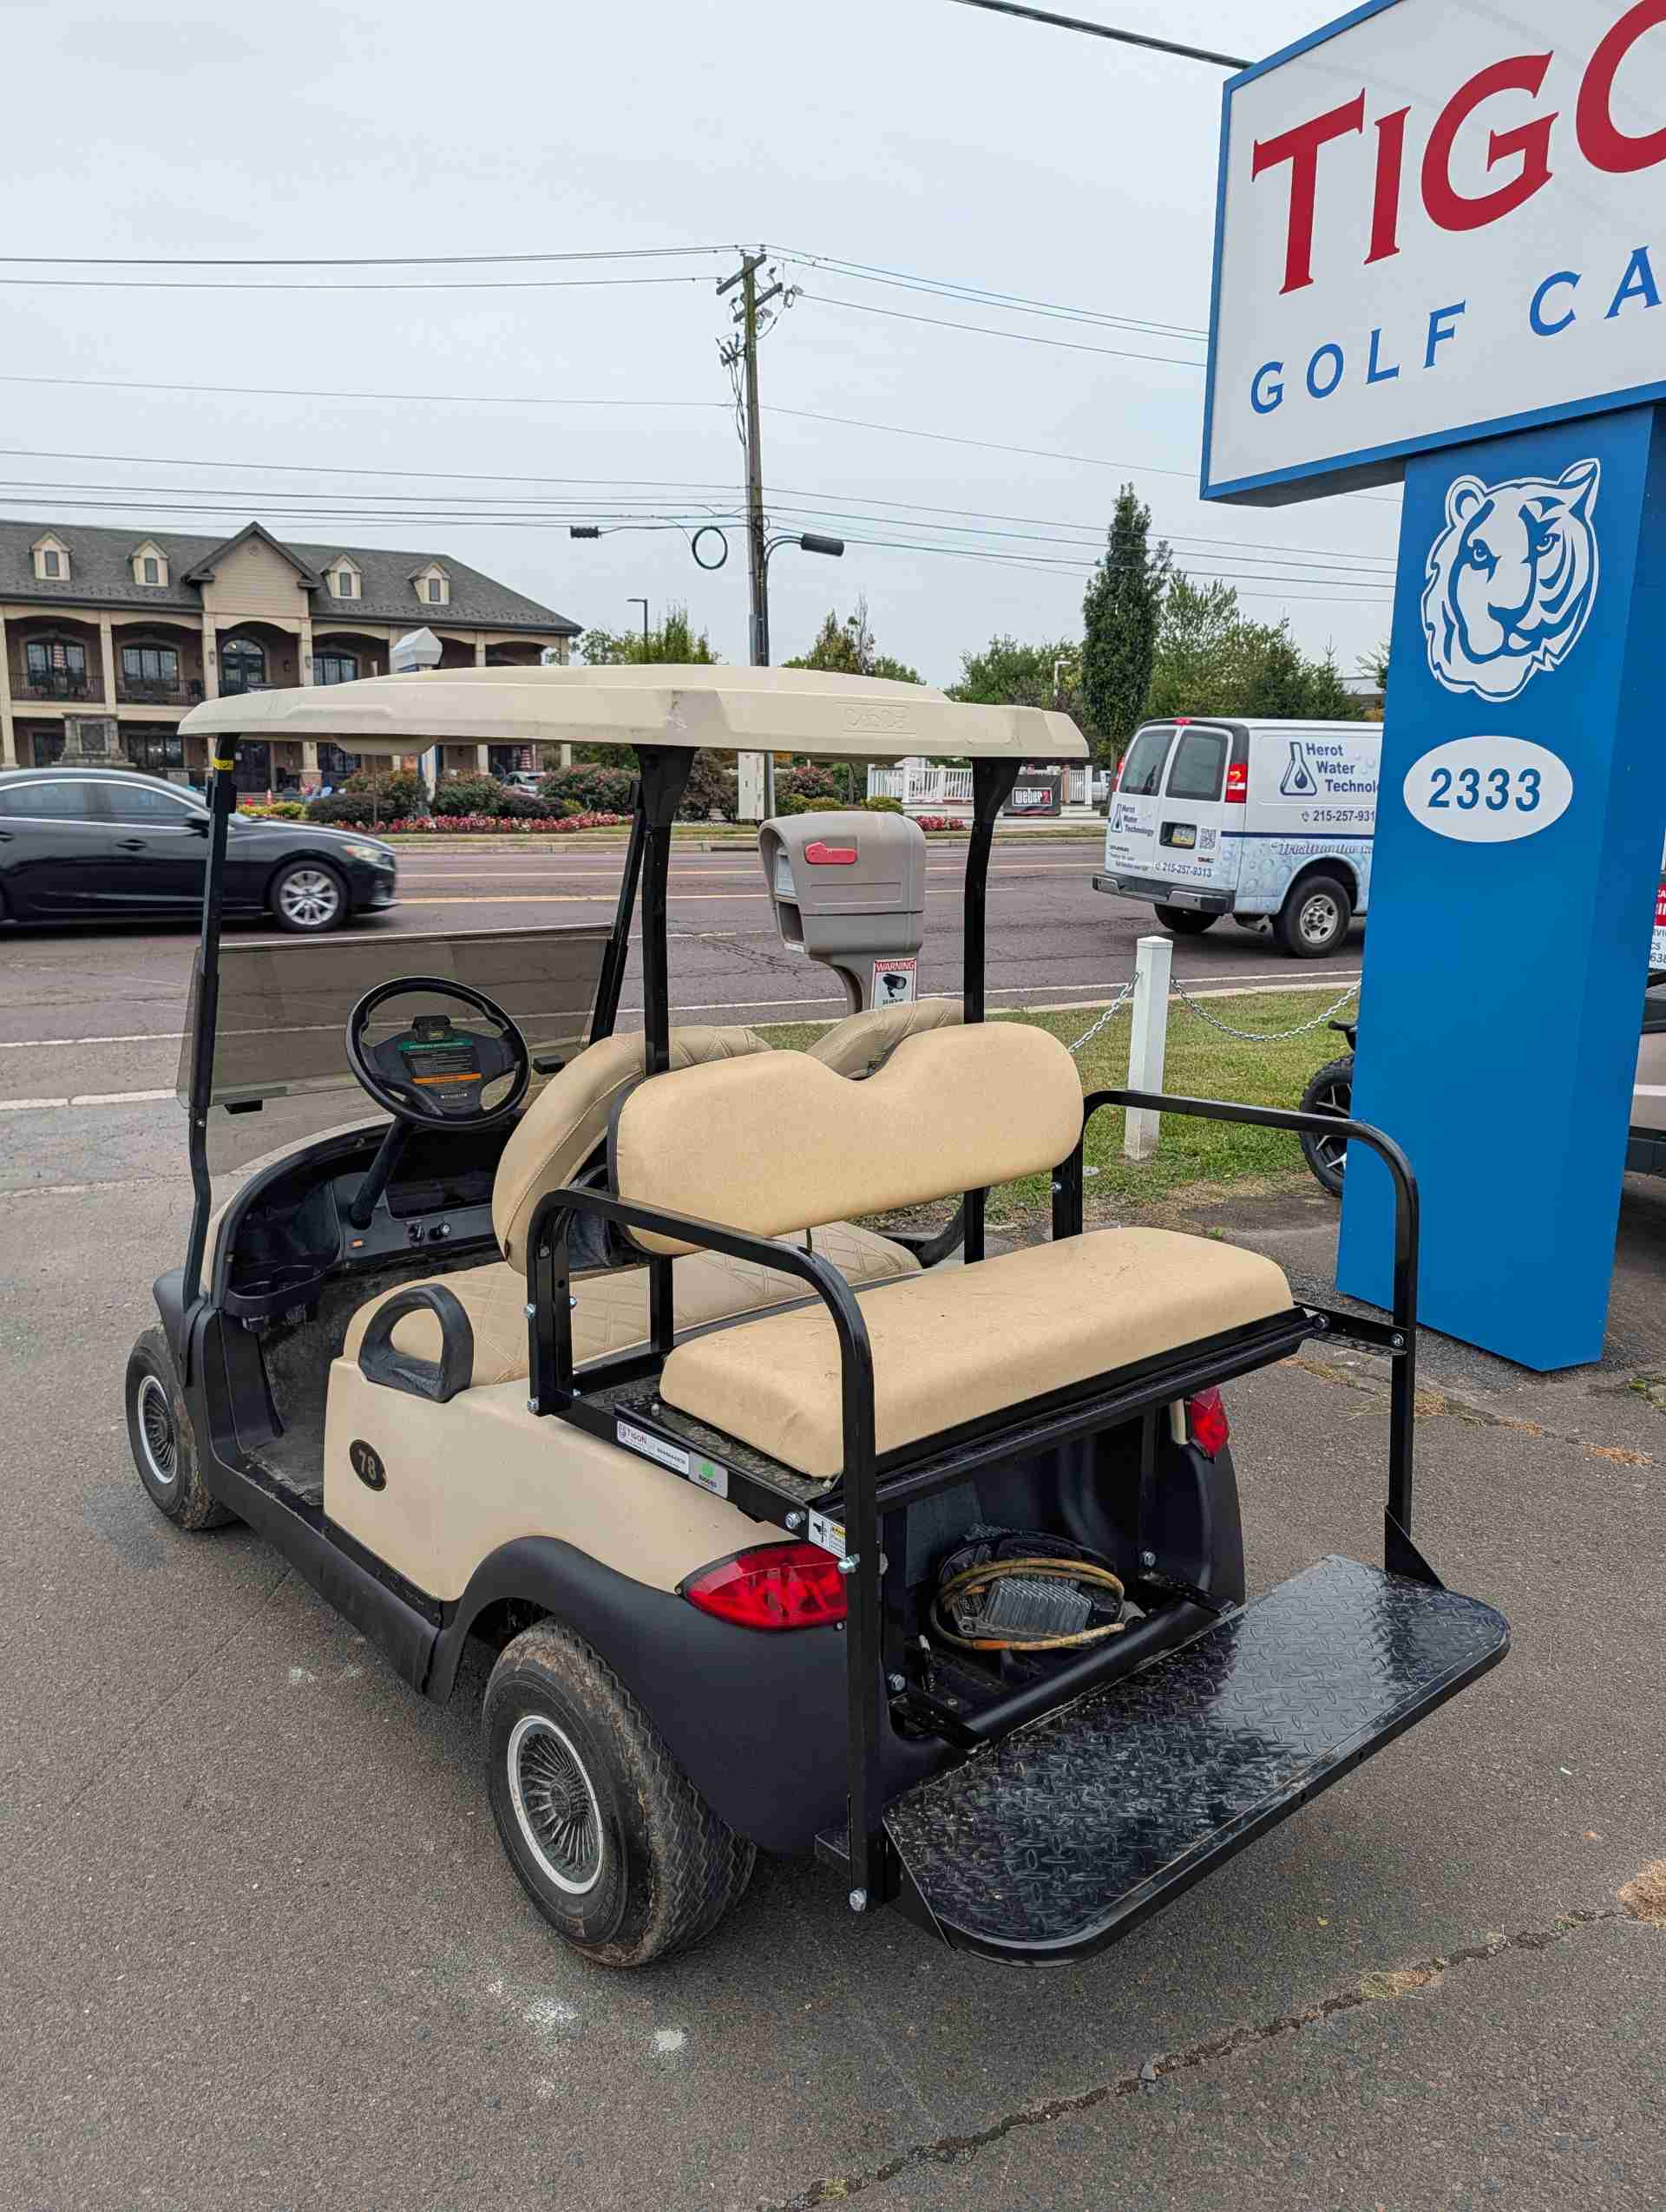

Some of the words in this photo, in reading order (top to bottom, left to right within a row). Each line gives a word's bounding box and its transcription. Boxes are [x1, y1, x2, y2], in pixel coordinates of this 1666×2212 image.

[1250, 300, 1466, 415] GOLF
[1305, 743, 1343, 756] Herot
[1316, 761, 1355, 774] Water
[1325, 778, 1379, 792] Technol
[1427, 767, 1542, 812] 2333
[876, 960, 915, 972] WARNING
[358, 1448, 377, 1481] 78
